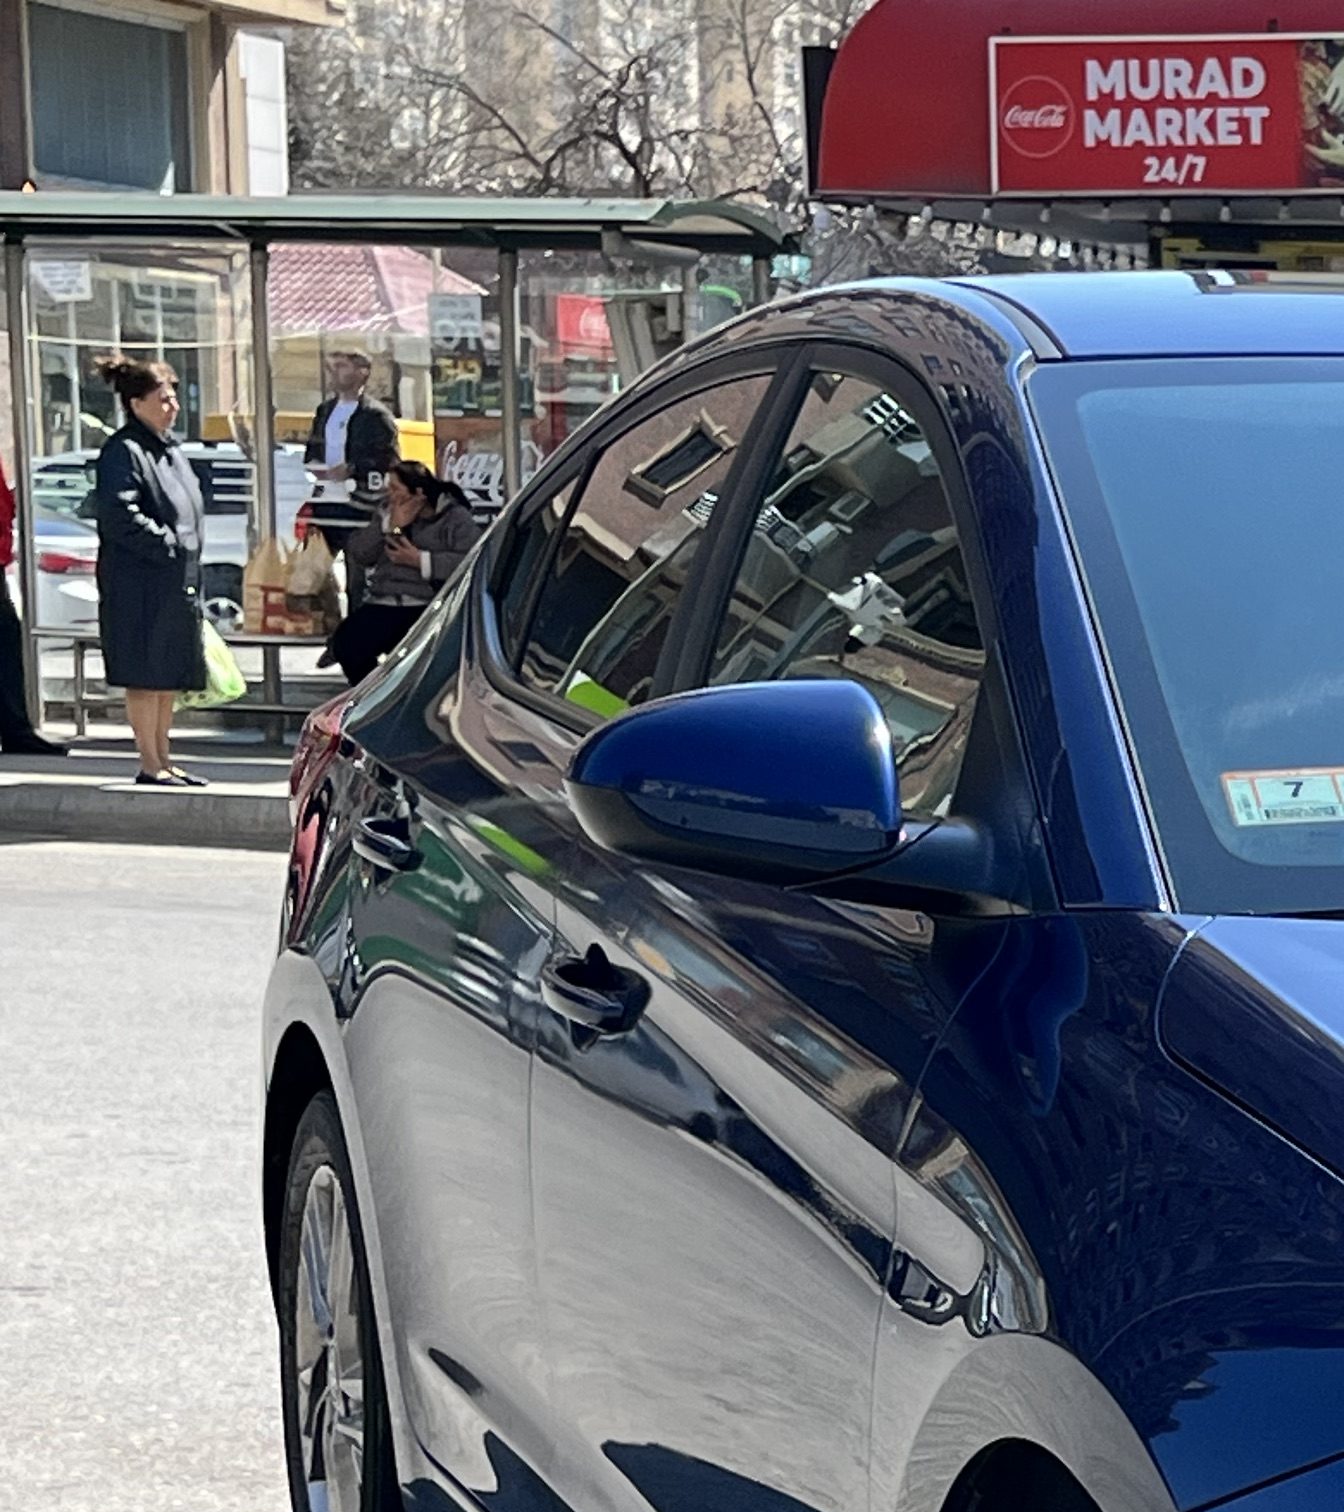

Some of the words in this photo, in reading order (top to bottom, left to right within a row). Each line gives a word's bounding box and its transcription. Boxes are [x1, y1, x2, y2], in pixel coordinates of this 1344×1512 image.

[1084, 57, 1267, 101] MURAD
[1083, 106, 1271, 148] MARKET
[1143, 153, 1207, 185] 24/7
[1283, 781, 1303, 798] 7
